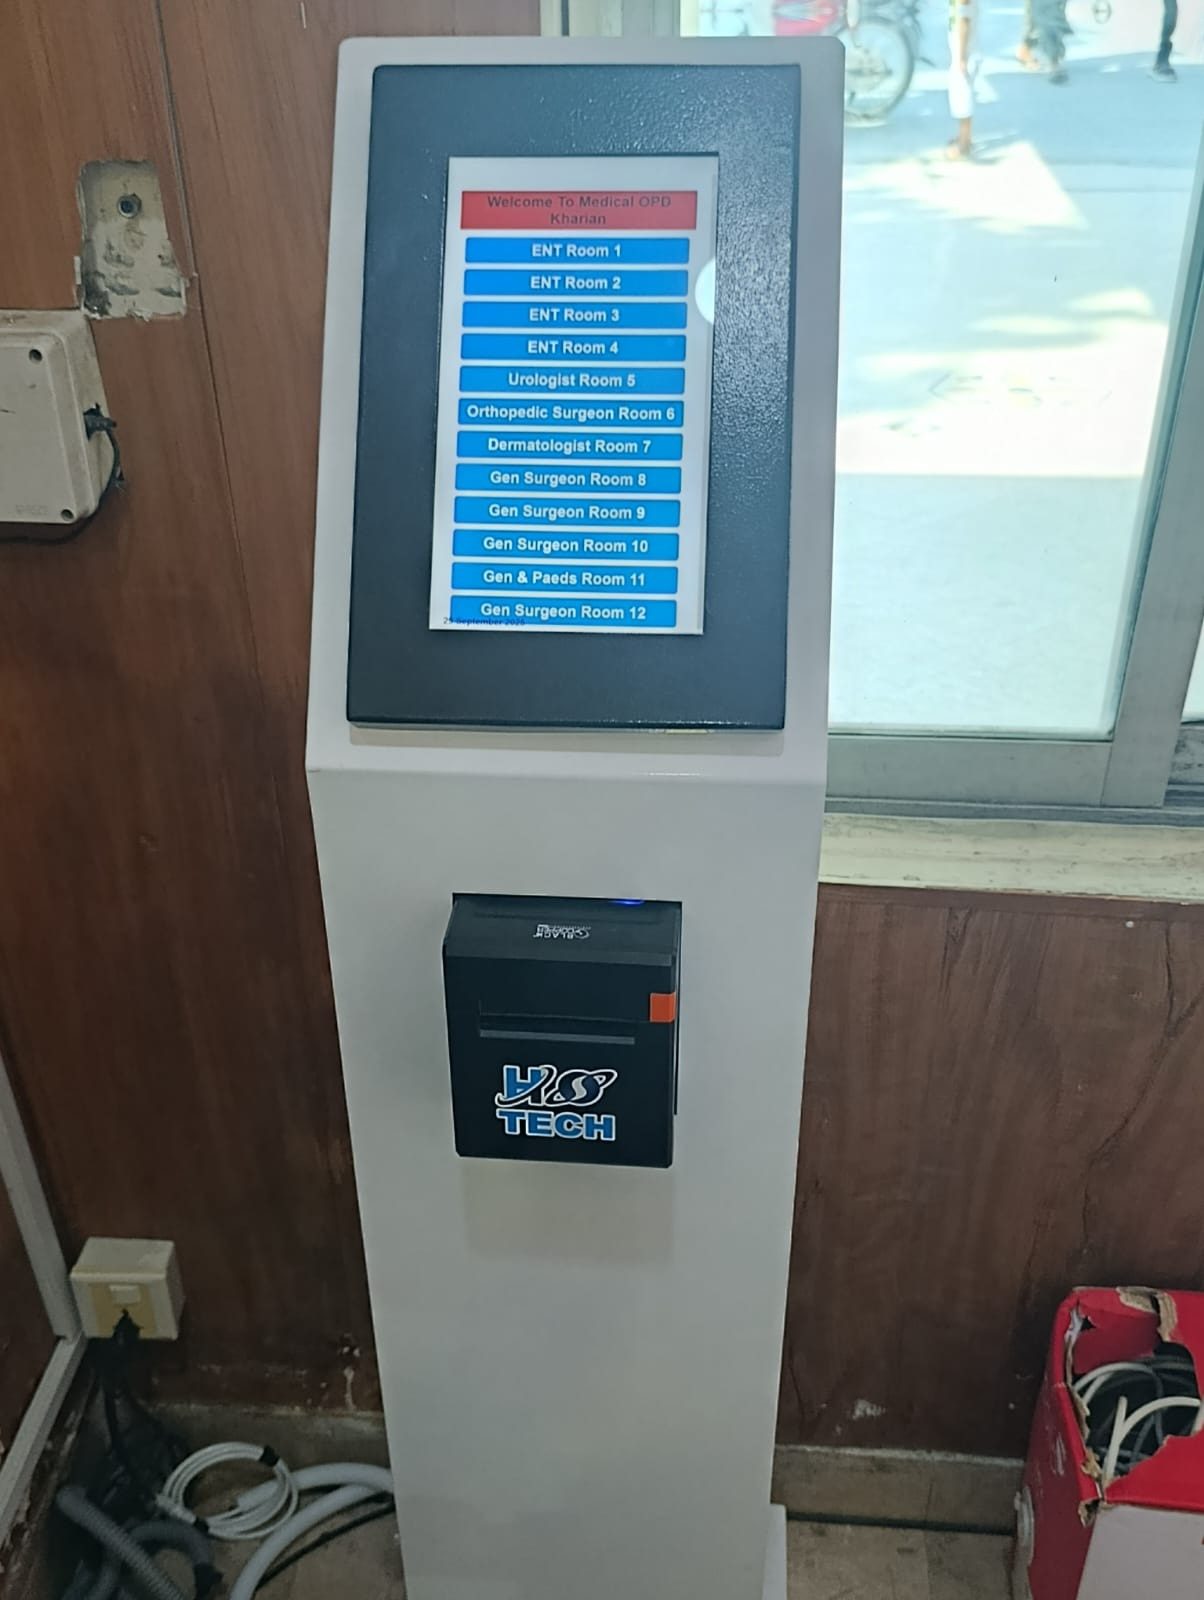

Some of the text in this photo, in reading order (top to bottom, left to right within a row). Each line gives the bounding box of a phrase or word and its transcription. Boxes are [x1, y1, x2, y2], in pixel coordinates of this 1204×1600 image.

[488, 196, 671, 208] Welcome To Medical OPD
[550, 213, 606, 225] Kharian
[532, 244, 622, 257] ENT Room 1
[530, 276, 622, 290] ENT Room 2
[530, 308, 620, 322] ENT Room 3
[528, 340, 618, 354] ENT Room 4
[508, 372, 636, 389] Urologist Room 5
[467, 405, 675, 422] Orthopedic Surgeon Room 6
[488, 438, 650, 454] Dermatologist Room 7
[490, 471, 646, 488] Gen Surgeon Room 8
[488, 504, 646, 520] Gen Surgeon Room 9
[484, 537, 648, 554] Gen Surgeon Room 10
[484, 570, 646, 586] Gen & Paeds Room 11
[481, 603, 646, 620] Gen Surgeon Room 12
[496, 1108, 616, 1141] TECH
